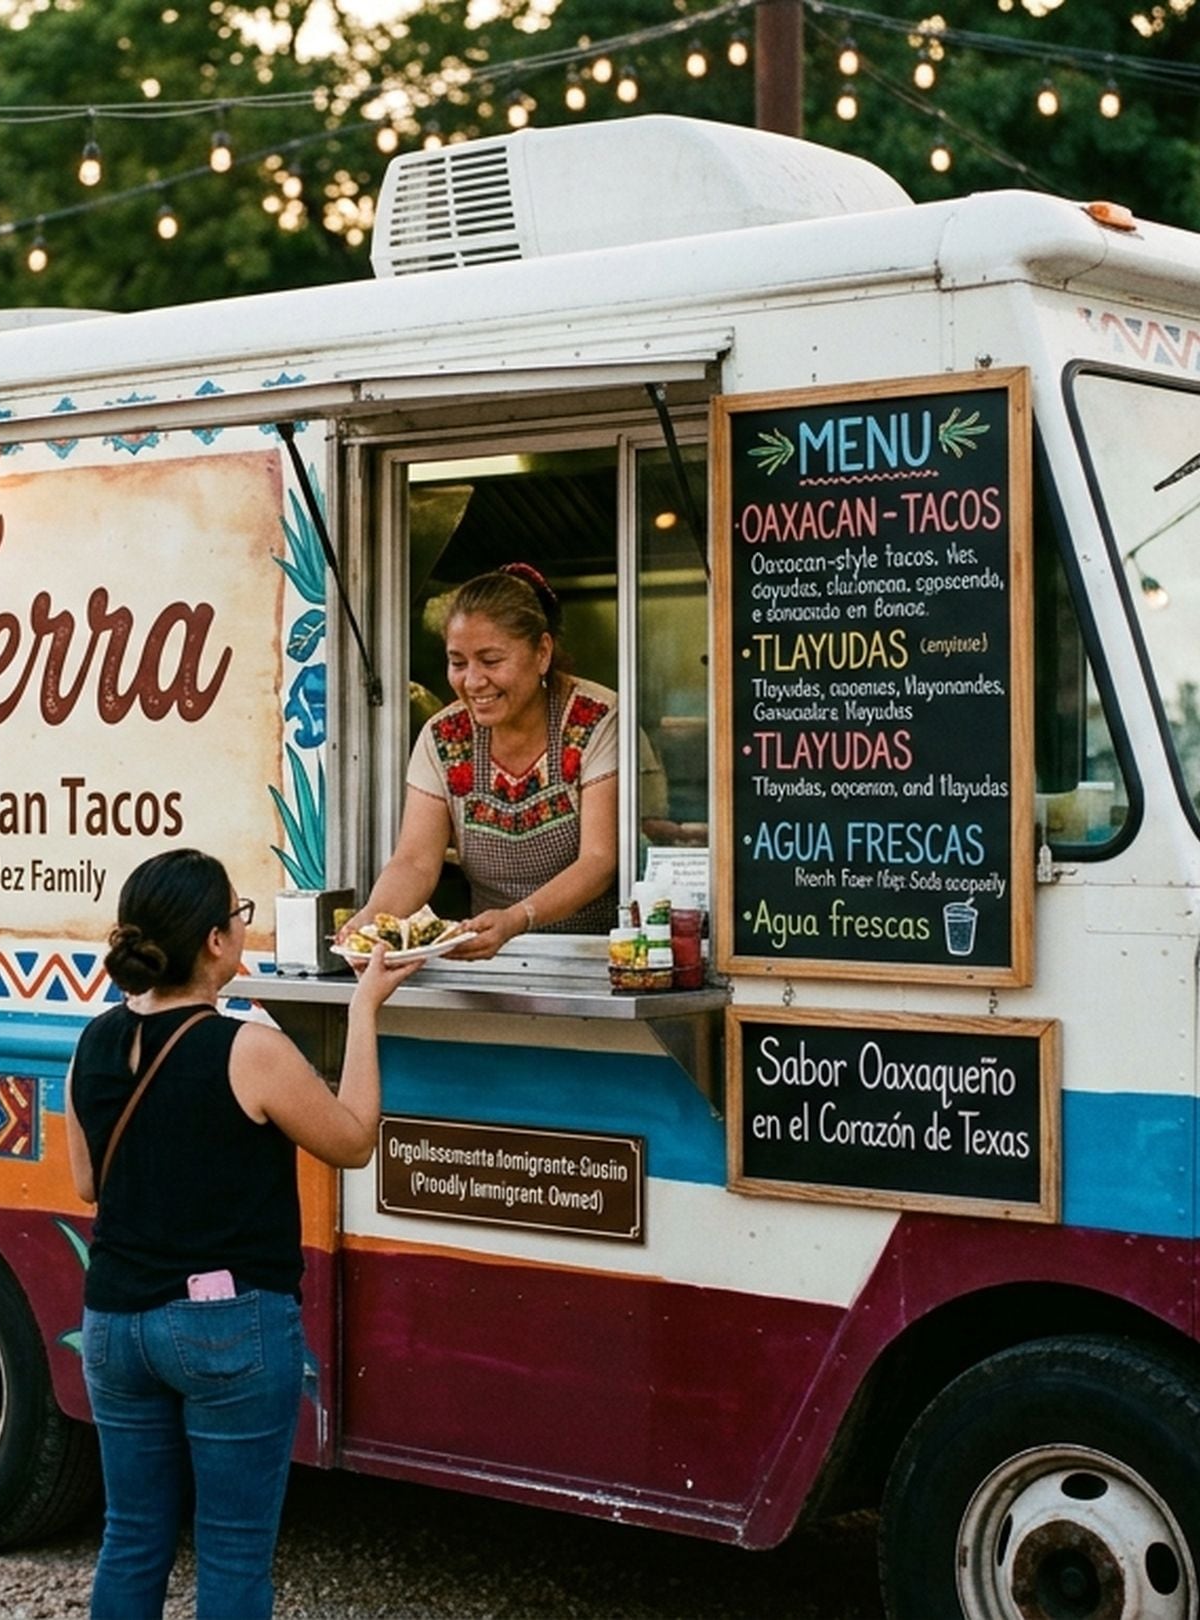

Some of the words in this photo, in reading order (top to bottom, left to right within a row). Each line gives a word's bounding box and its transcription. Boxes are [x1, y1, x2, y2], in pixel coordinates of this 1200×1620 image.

[800, 411, 932, 475] MENU
[752, 629, 909, 672] TLAYUDAS
[753, 730, 913, 770] TLAYUDAS
[61, 777, 184, 837] Tacos
[753, 822, 835, 862] AGUA
[847, 823, 985, 865] FRESCAS
[31, 860, 107, 903] Family
[753, 899, 820, 949] Agua
[829, 899, 931, 940] frescas
[756, 1035, 847, 1088] Sabor
[858, 1041, 1017, 1108] Oaxaqueño
[752, 1113, 781, 1141] en
[789, 1102, 809, 1142] el
[819, 1101, 915, 1150] Corazón
[923, 1112, 952, 1152] de
[958, 1110, 1031, 1159] Texas
